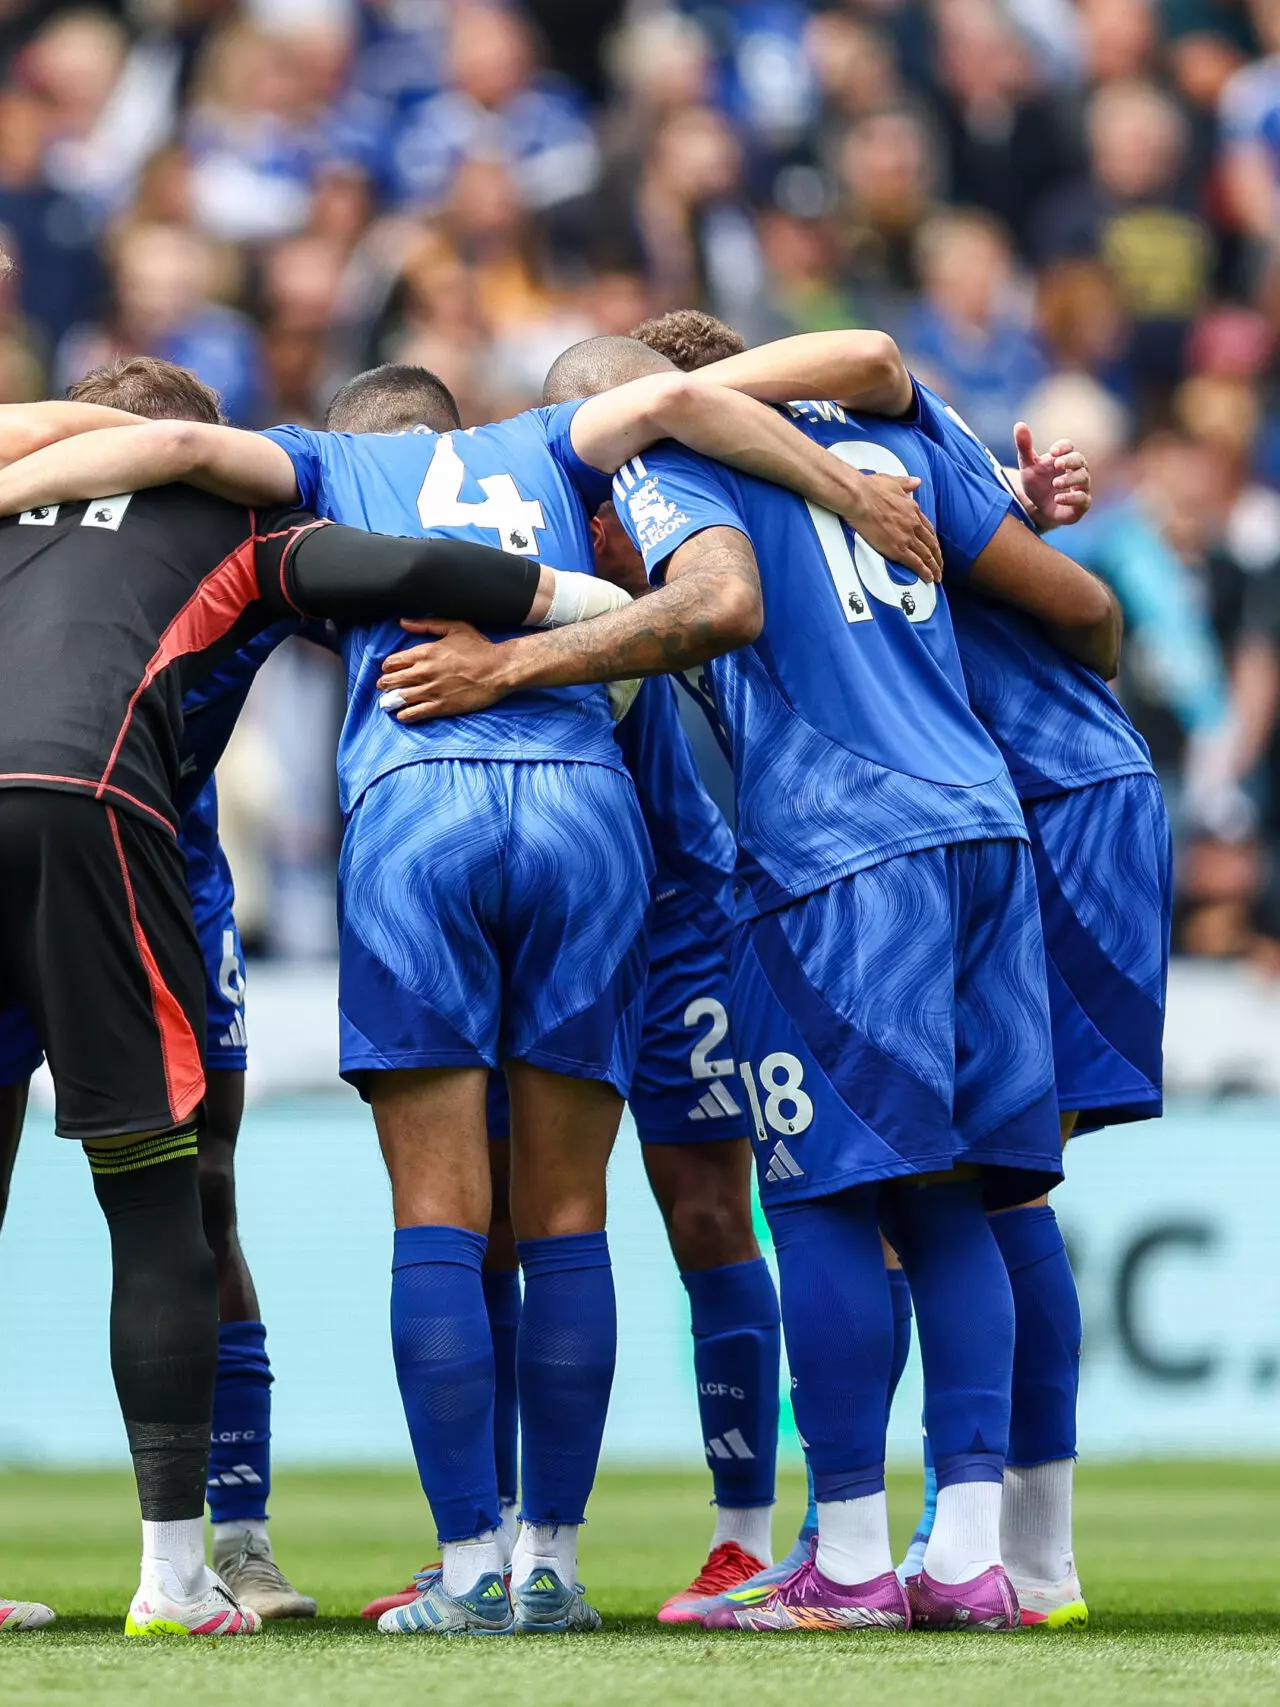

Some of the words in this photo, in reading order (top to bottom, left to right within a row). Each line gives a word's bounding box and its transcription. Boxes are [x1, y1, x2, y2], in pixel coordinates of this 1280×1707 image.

[416, 434, 547, 557] 4
[684, 997, 735, 1080] 2
[739, 1051, 814, 1142] 18
[699, 1381, 746, 1400] LCFC
[210, 1430, 256, 1443] LCFC
